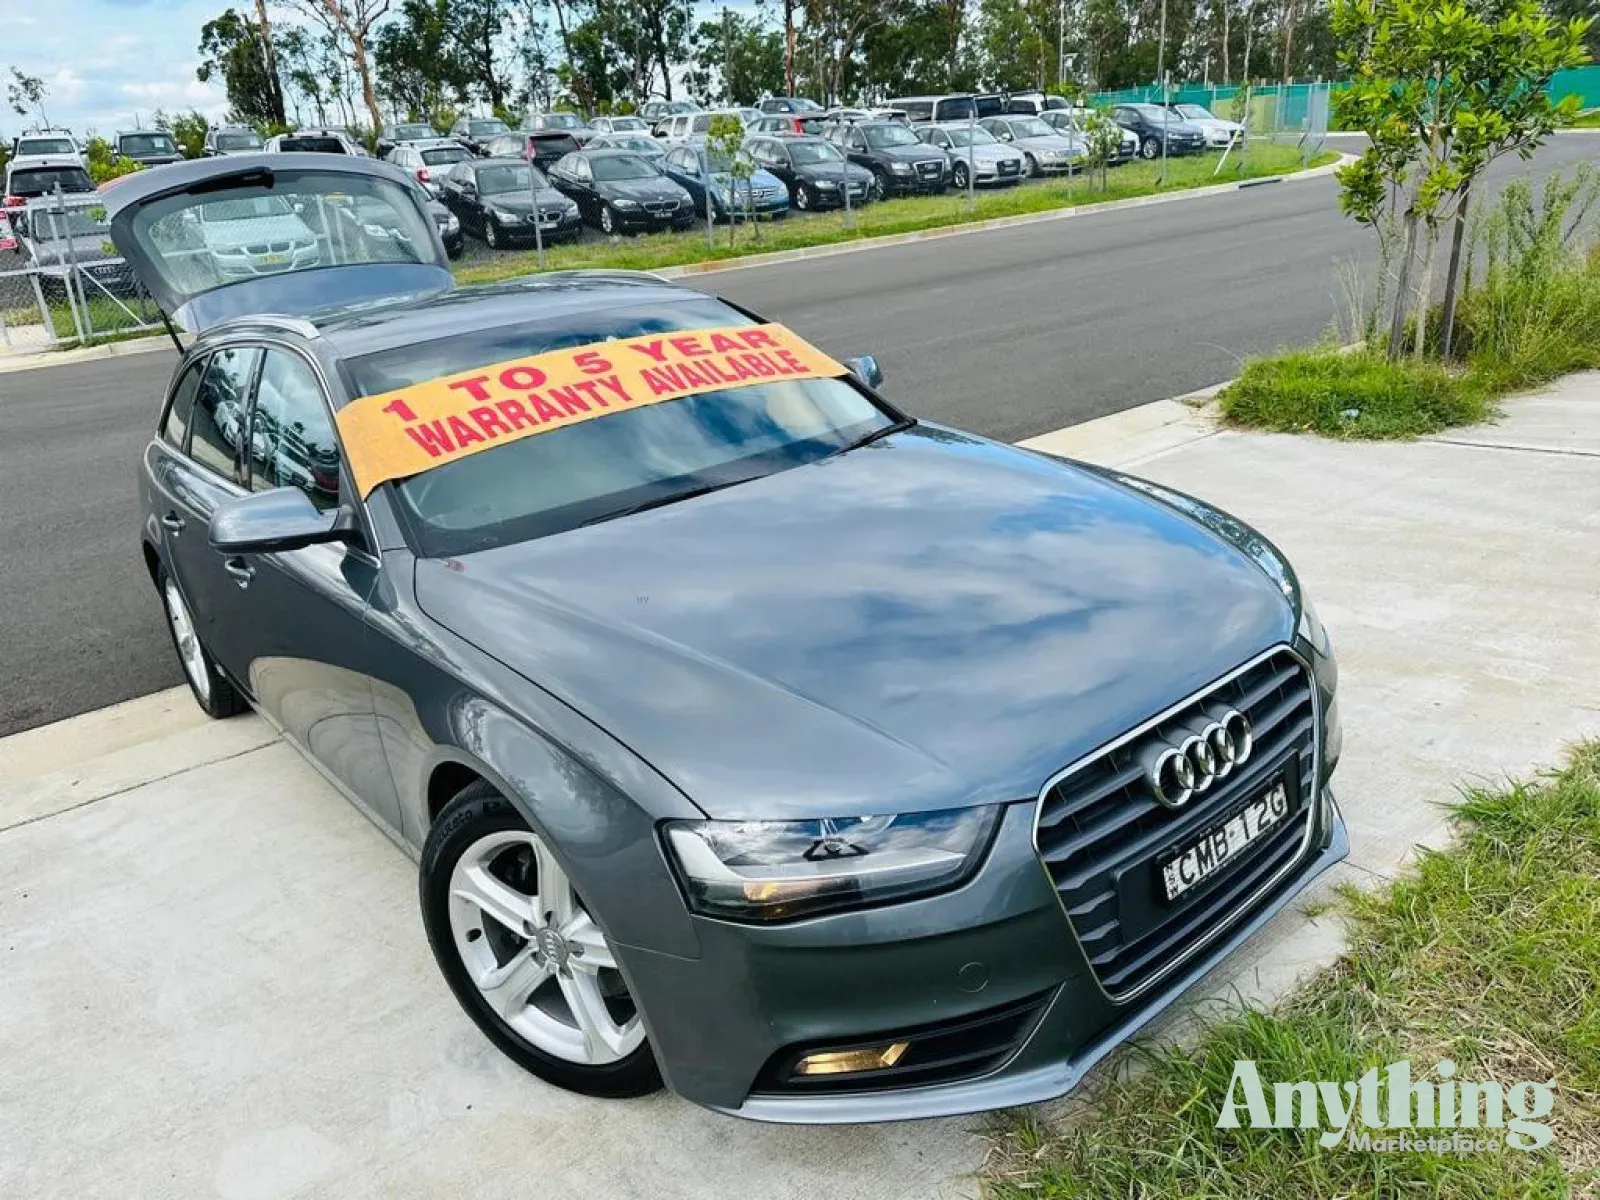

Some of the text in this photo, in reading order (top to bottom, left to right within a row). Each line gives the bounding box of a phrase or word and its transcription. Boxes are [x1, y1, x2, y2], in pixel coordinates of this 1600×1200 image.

[383, 329, 781, 422] 1 TO 5 YEAR
[405, 349, 809, 458] WARRANTY AVAILABLE
